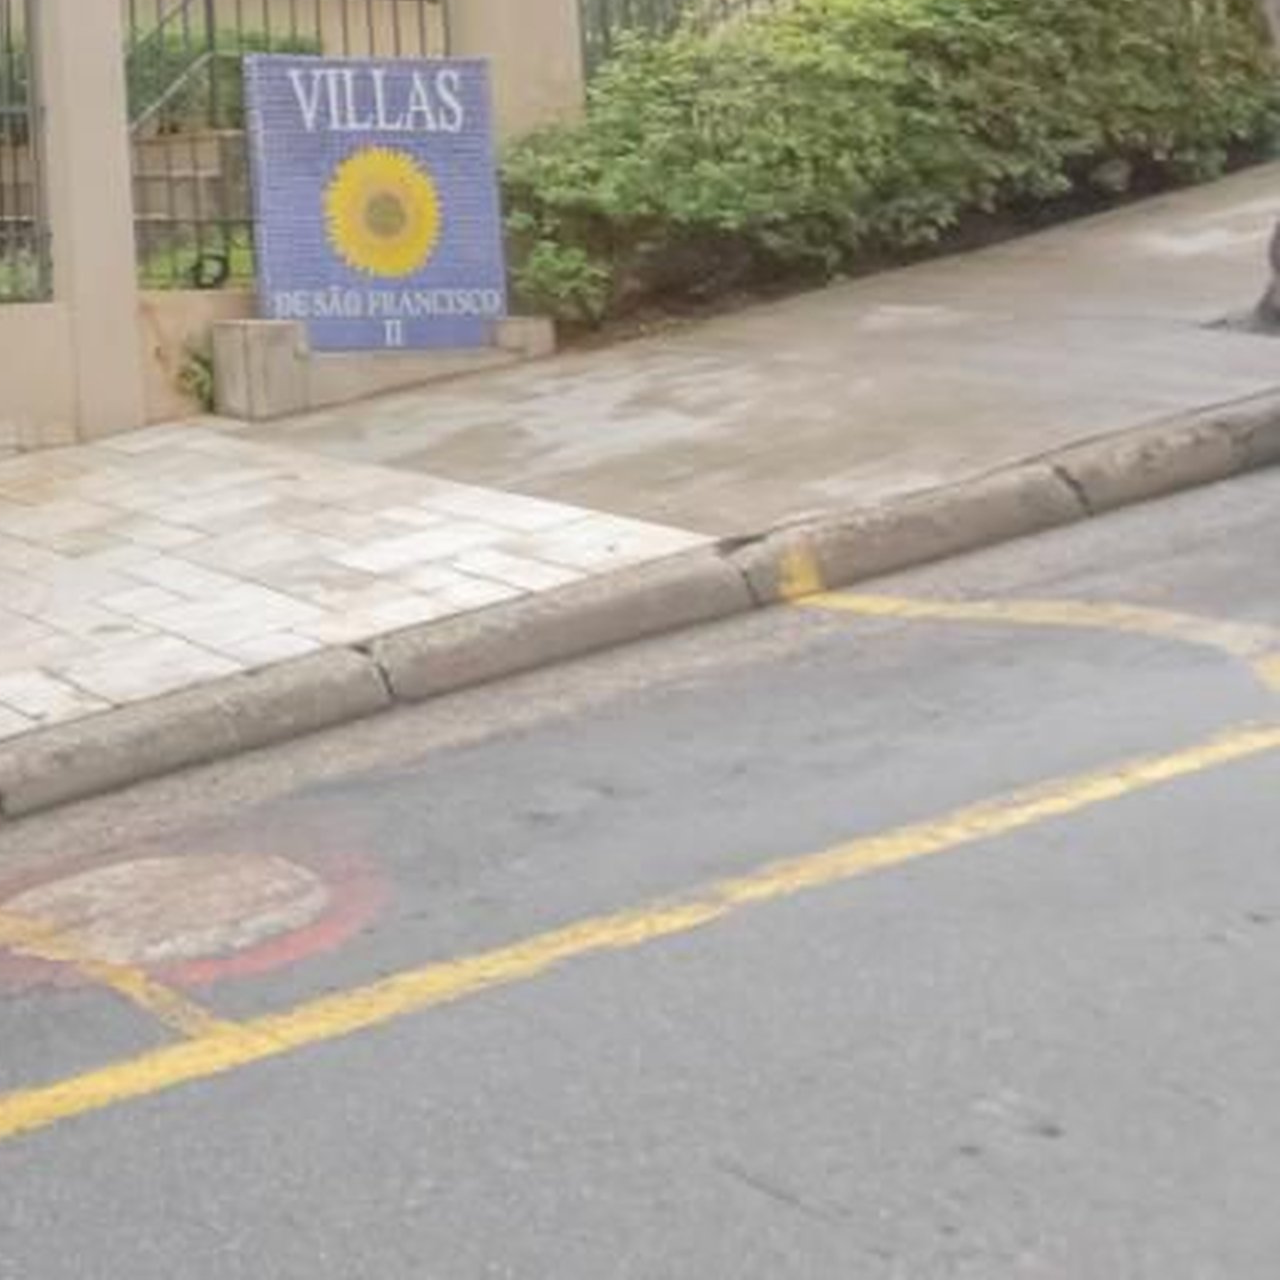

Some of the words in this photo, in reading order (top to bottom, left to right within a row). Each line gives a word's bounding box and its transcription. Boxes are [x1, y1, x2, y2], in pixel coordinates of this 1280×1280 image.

[289, 68, 464, 132] VILLAS
[274, 291, 309, 318] DE
[315, 286, 362, 317] SÃO
[369, 288, 502, 317] FRANCISCO
[384, 319, 403, 347] II
